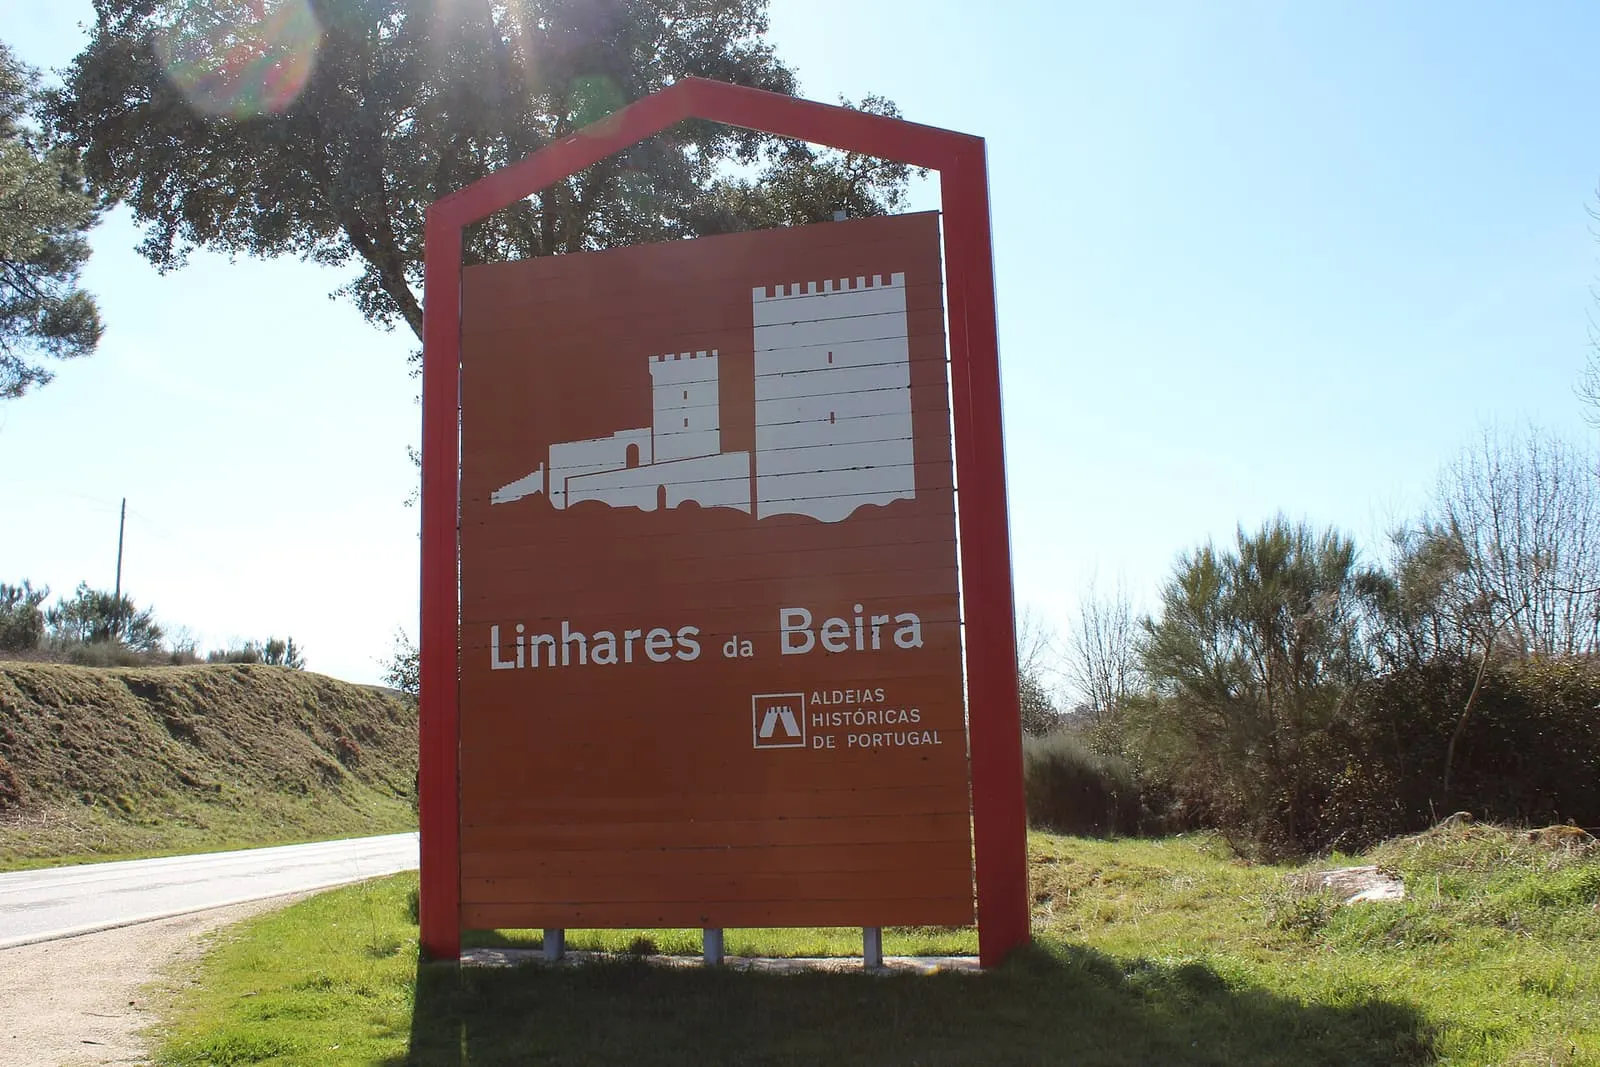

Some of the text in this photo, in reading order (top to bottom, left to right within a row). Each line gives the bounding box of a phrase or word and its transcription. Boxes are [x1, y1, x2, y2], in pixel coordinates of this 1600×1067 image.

[491, 603, 924, 670] Linhares da Beira
[811, 688, 885, 705] ALDEIAS
[812, 708, 921, 727] HISTÓRICAS
[813, 731, 942, 749] DE PORTUGAL
